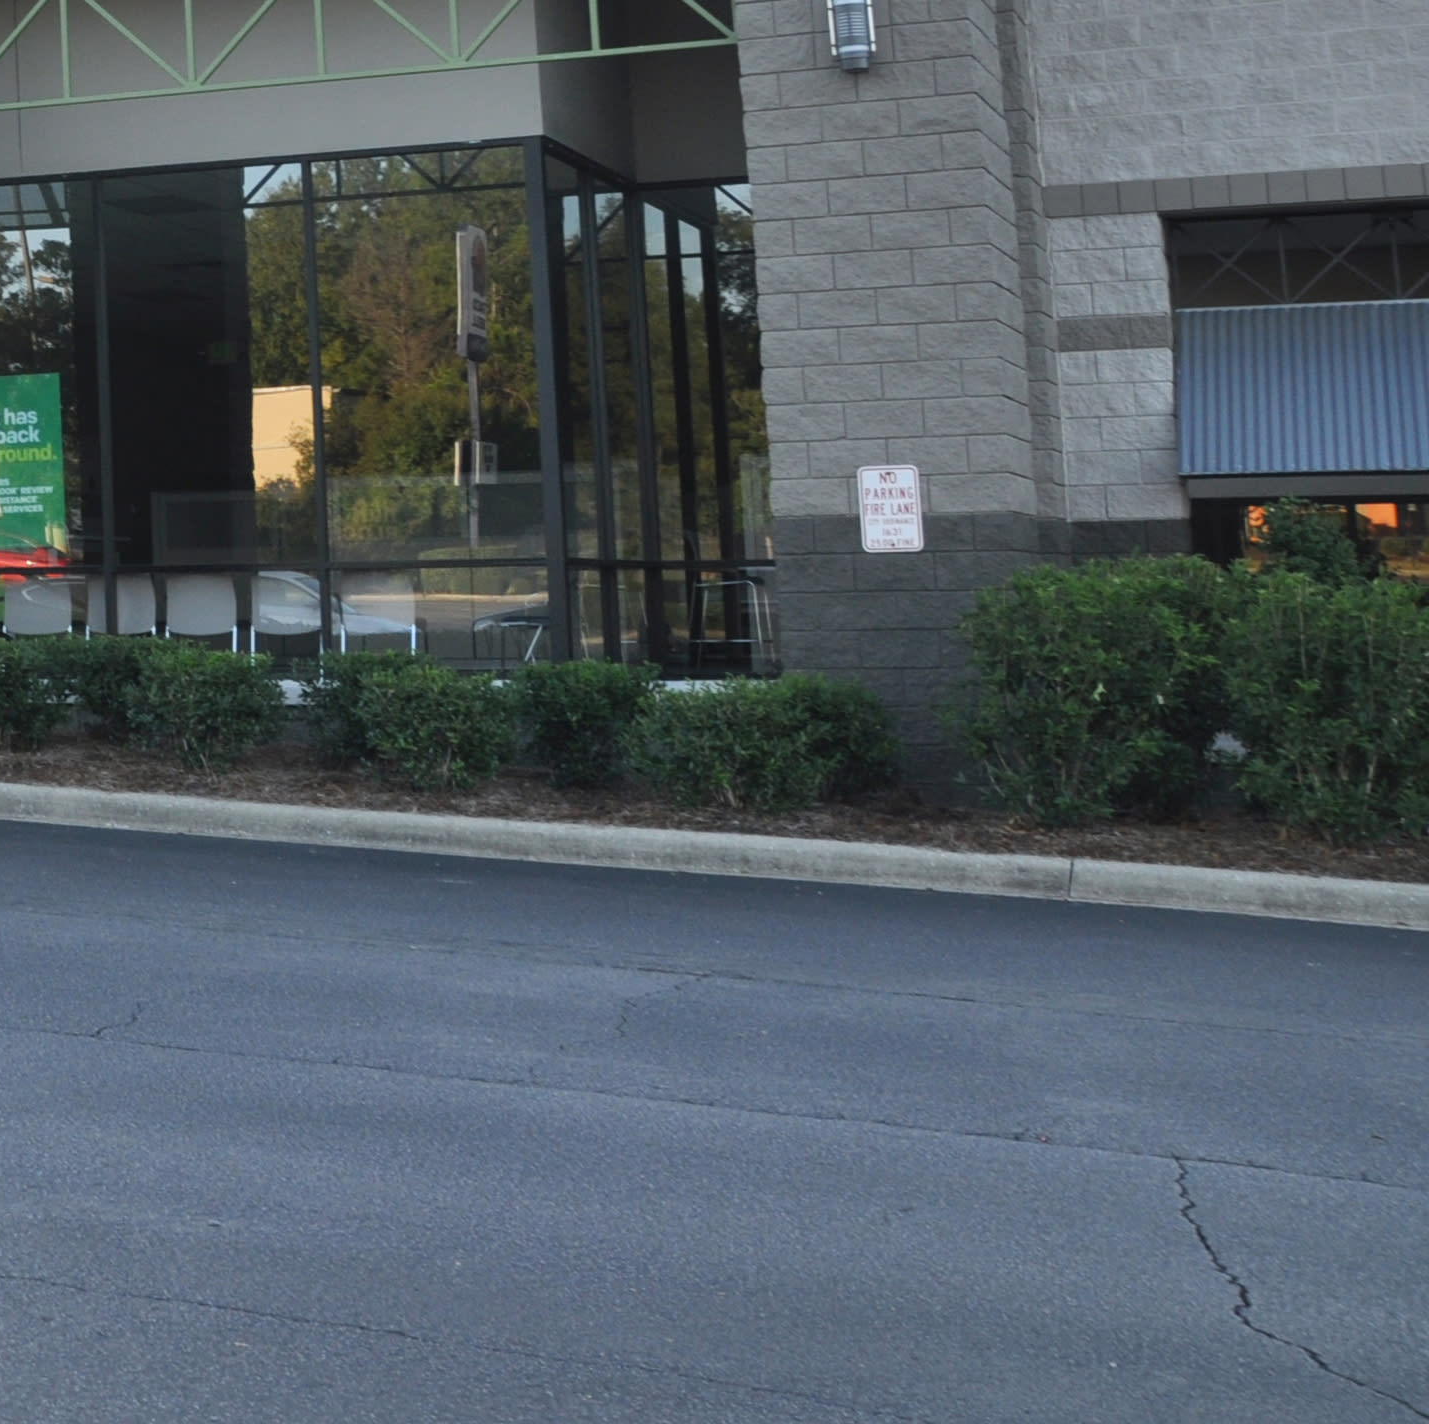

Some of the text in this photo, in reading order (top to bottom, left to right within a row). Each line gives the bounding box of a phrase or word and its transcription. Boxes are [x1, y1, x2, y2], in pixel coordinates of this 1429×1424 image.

[4, 407, 38, 426] has
[878, 471, 897, 484] NO
[20, 485, 54, 495] REVIEW
[864, 487, 915, 500] PARKING
[3, 504, 44, 514] SERVICES
[864, 502, 917, 516] FIRE LANE
